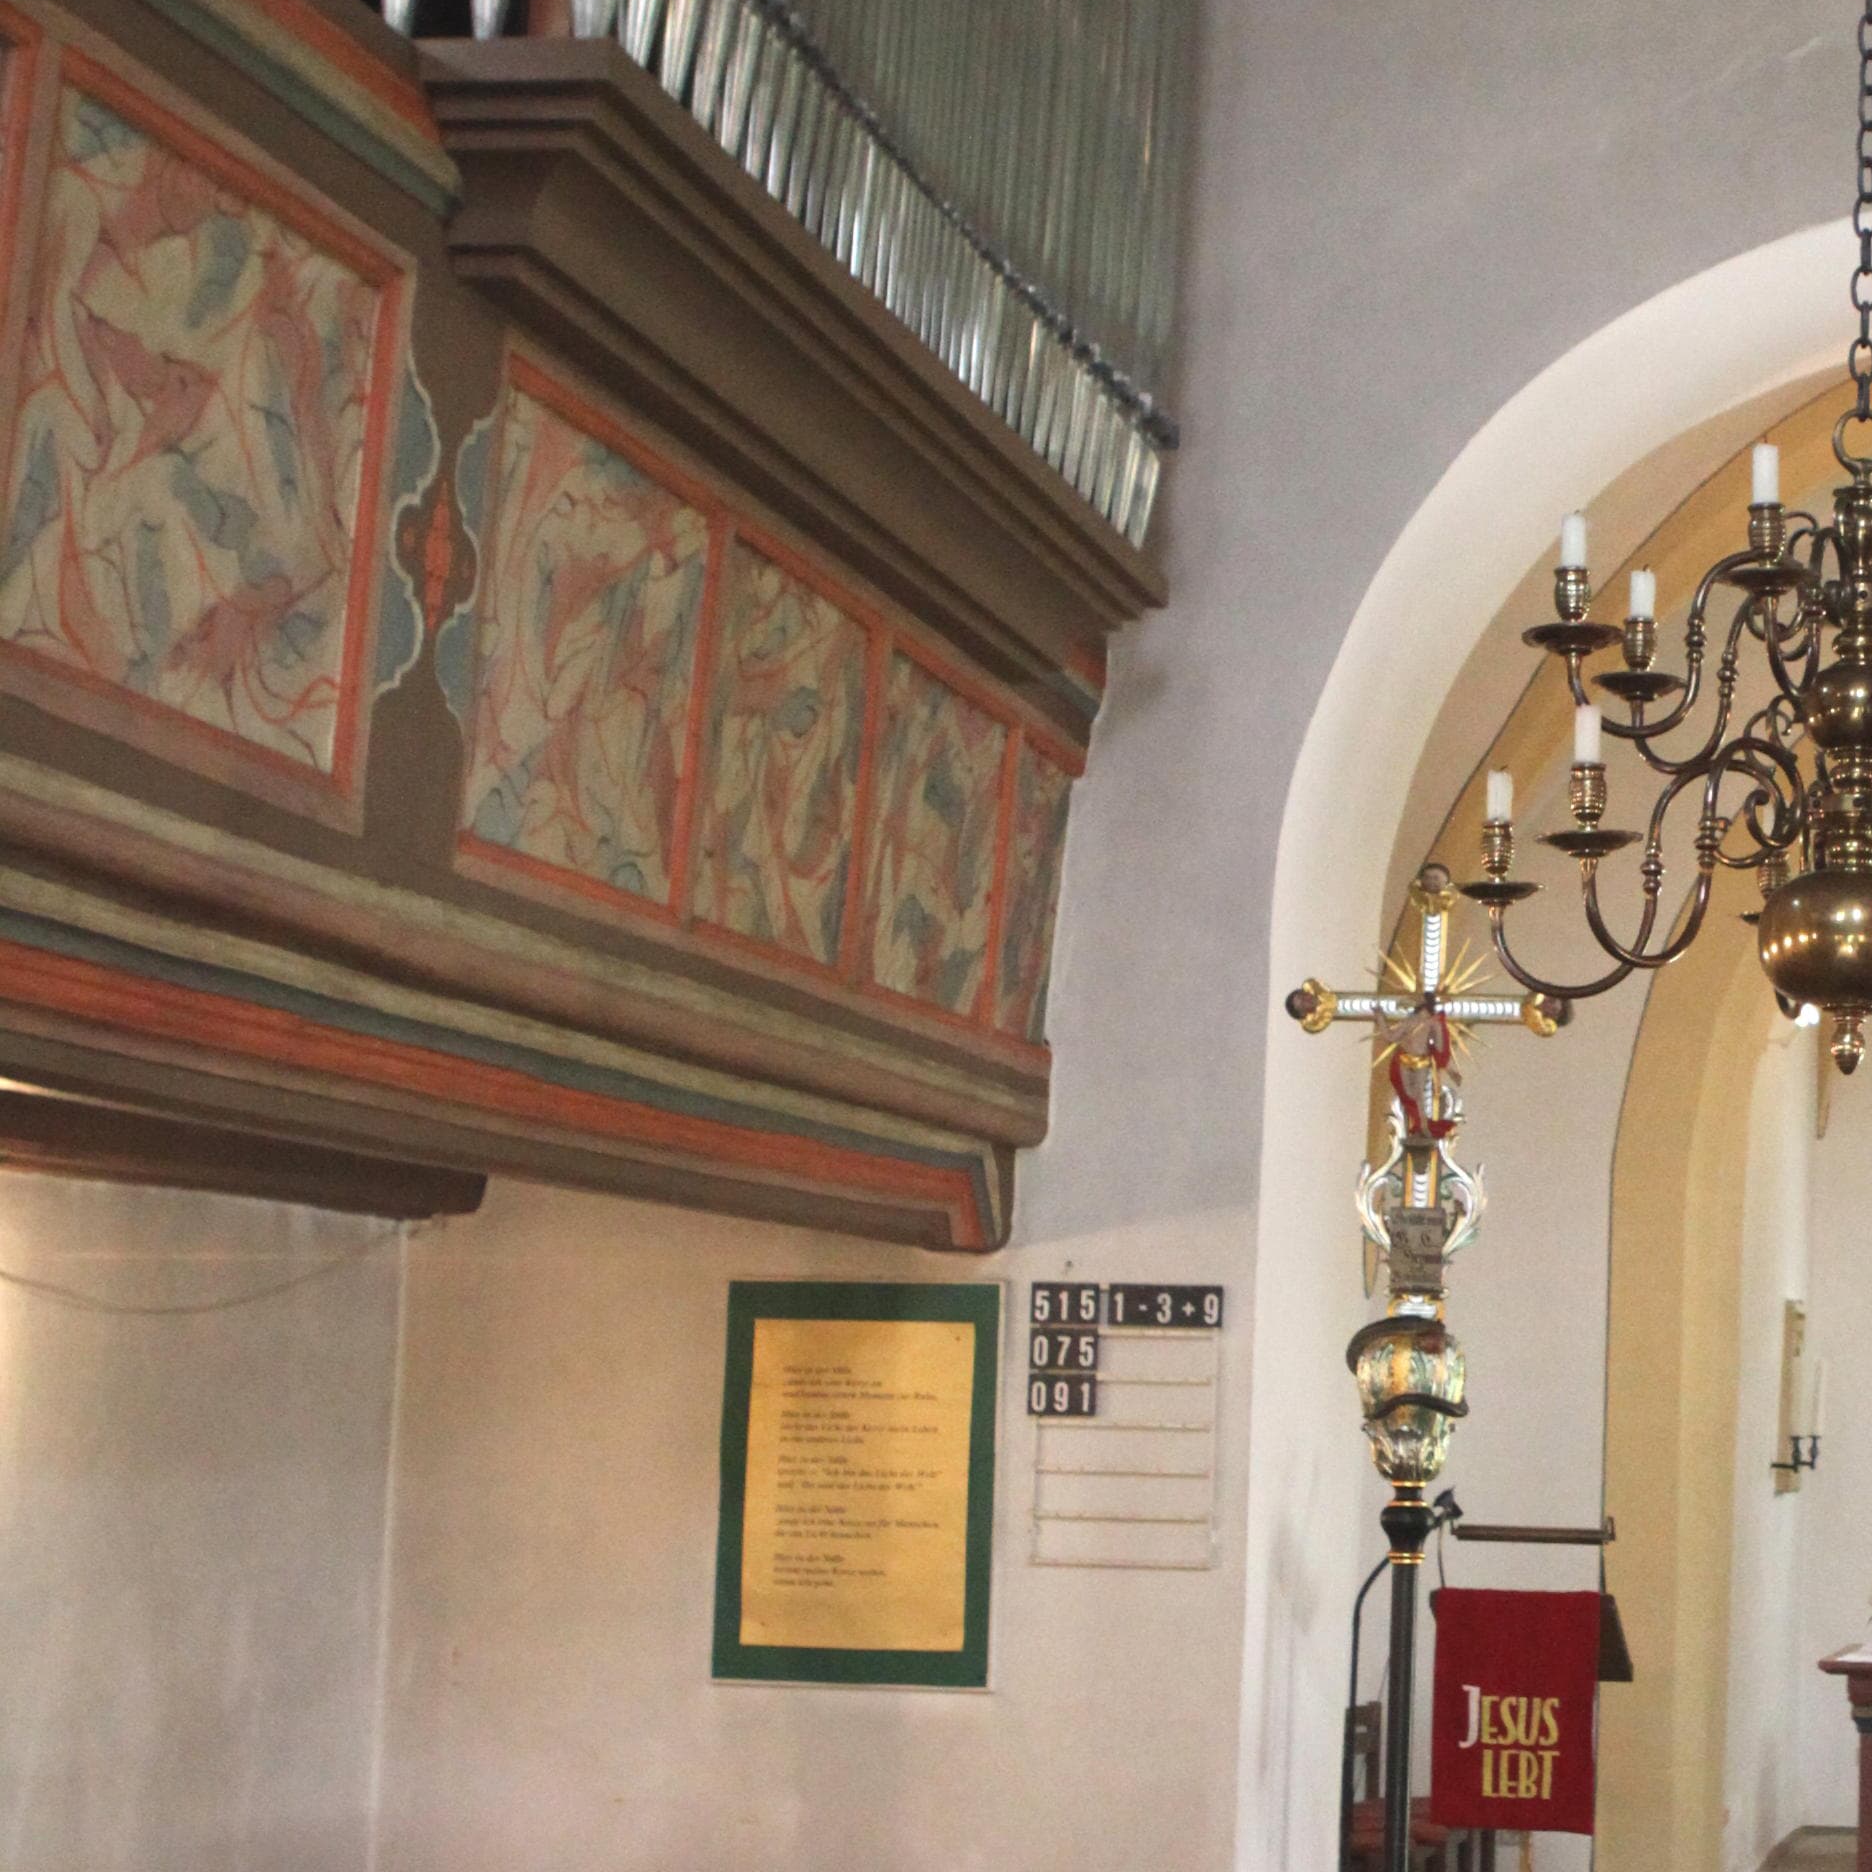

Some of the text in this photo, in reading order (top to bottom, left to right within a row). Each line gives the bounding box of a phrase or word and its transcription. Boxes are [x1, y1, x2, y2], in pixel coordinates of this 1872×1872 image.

[1033, 1289, 1096, 1321] 515
[1032, 1335, 1095, 1367] 075
[1031, 1381, 1091, 1413] 091
[1458, 1684, 1561, 1749] JESUS
[1481, 1749, 1561, 1800] LEBT
